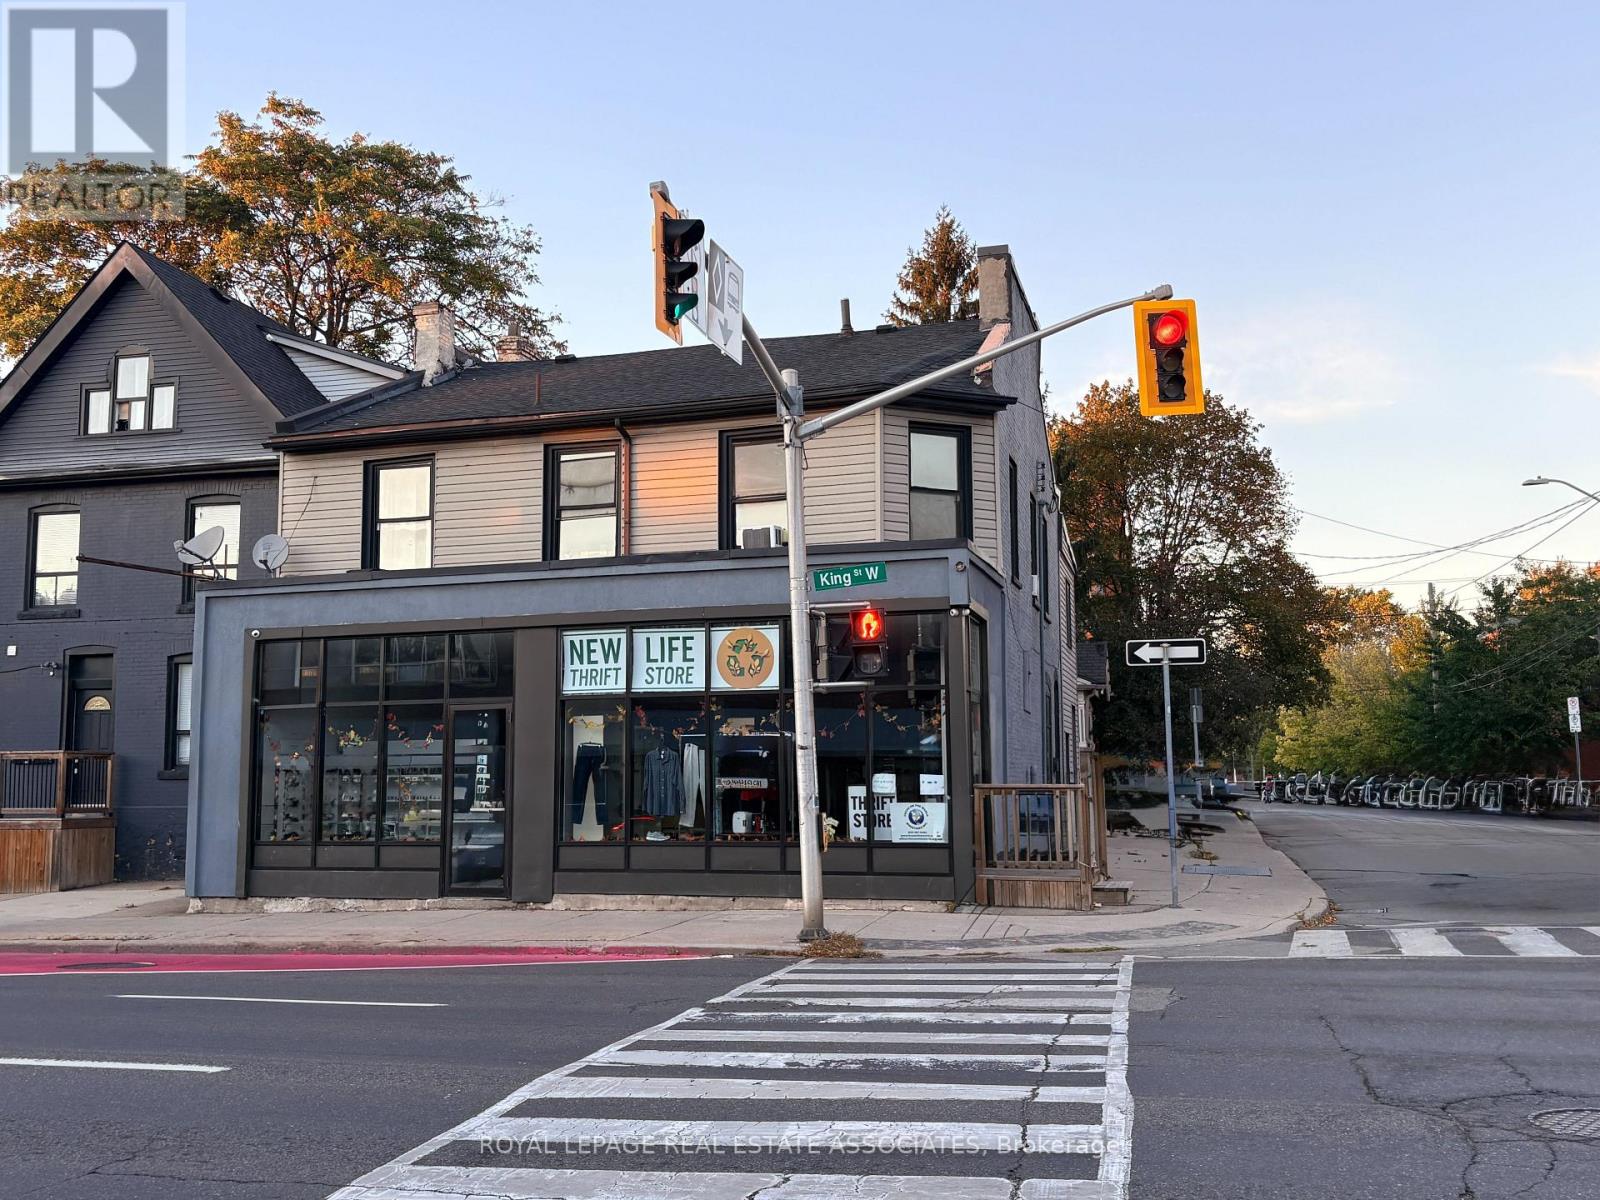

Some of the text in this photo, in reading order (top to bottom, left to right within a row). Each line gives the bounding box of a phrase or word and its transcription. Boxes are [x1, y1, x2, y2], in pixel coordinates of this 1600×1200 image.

[820, 572, 851, 587] King
[865, 566, 879, 580] W
[569, 636, 695, 665] NEW LIFE
[569, 665, 695, 687] THRIFT STORE
